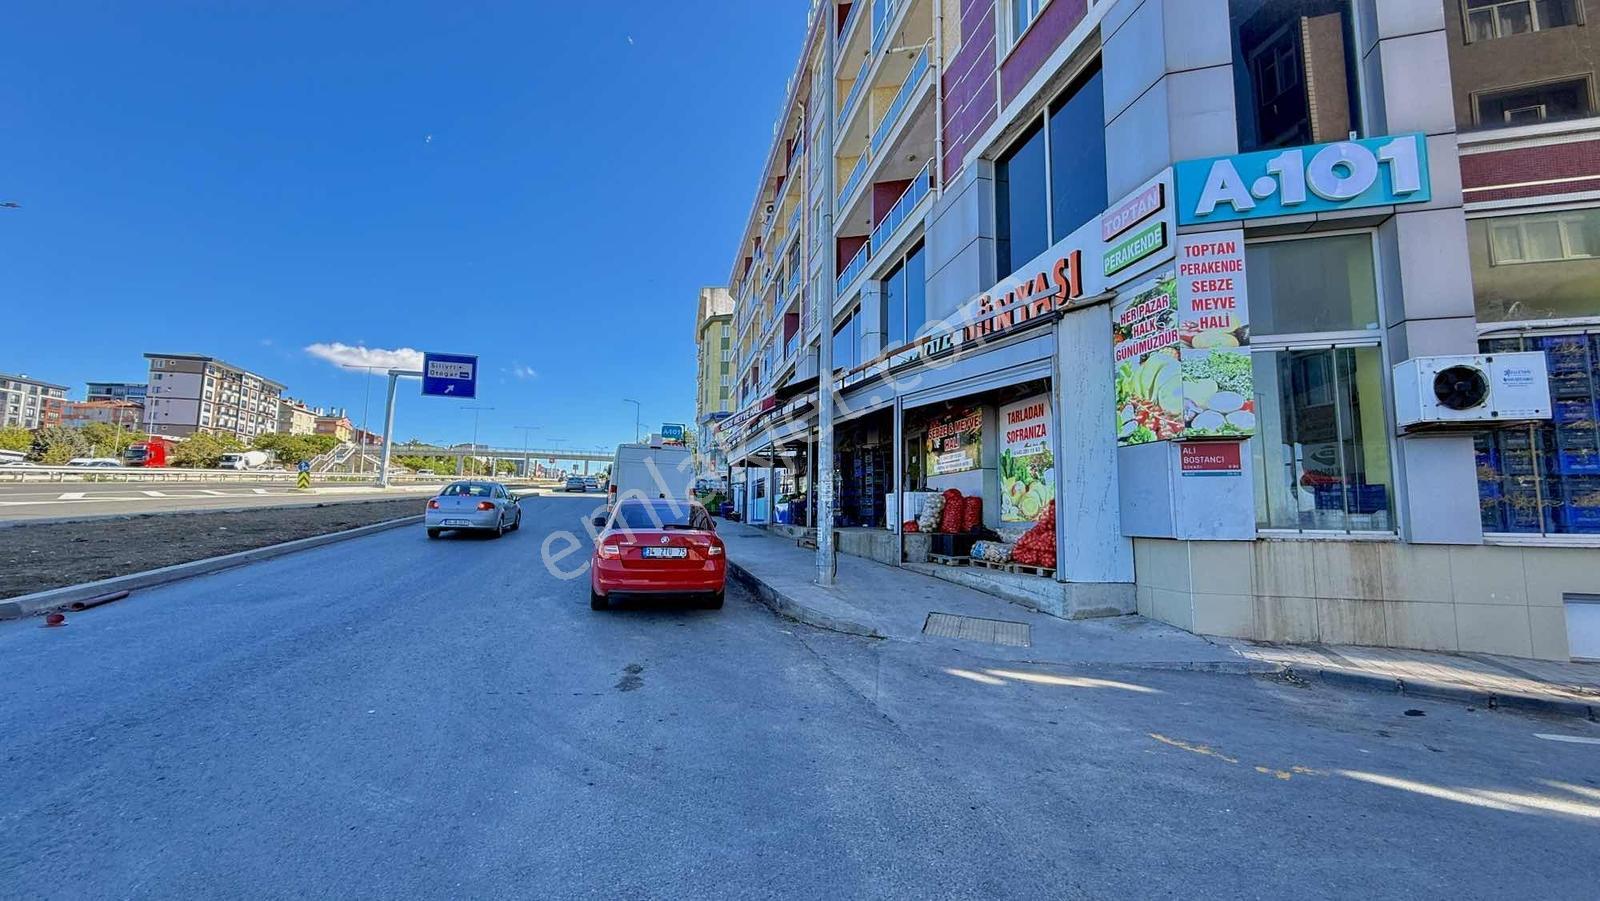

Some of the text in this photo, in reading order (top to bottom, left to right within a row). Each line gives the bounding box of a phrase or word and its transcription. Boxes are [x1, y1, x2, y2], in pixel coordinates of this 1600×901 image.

[1104, 187, 1157, 234] TOPTAN
[1104, 227, 1161, 272] PERAKENDE
[1184, 242, 1236, 257] TOPTAN
[1180, 259, 1242, 276] PERAKENDE
[1191, 279, 1233, 293] SEBZE
[1120, 294, 1169, 326] HER PAZAR
[1191, 297, 1236, 312] MEYVE
[1133, 319, 1157, 338] HALK
[1200, 312, 1230, 329] HALİ
[1115, 329, 1179, 362] GÜNÜMÜZDÜR
[1007, 403, 1044, 424] TARLADAN
[1006, 423, 1047, 444] SOFRANIZA
[1183, 456, 1225, 464] BOSTANCI
